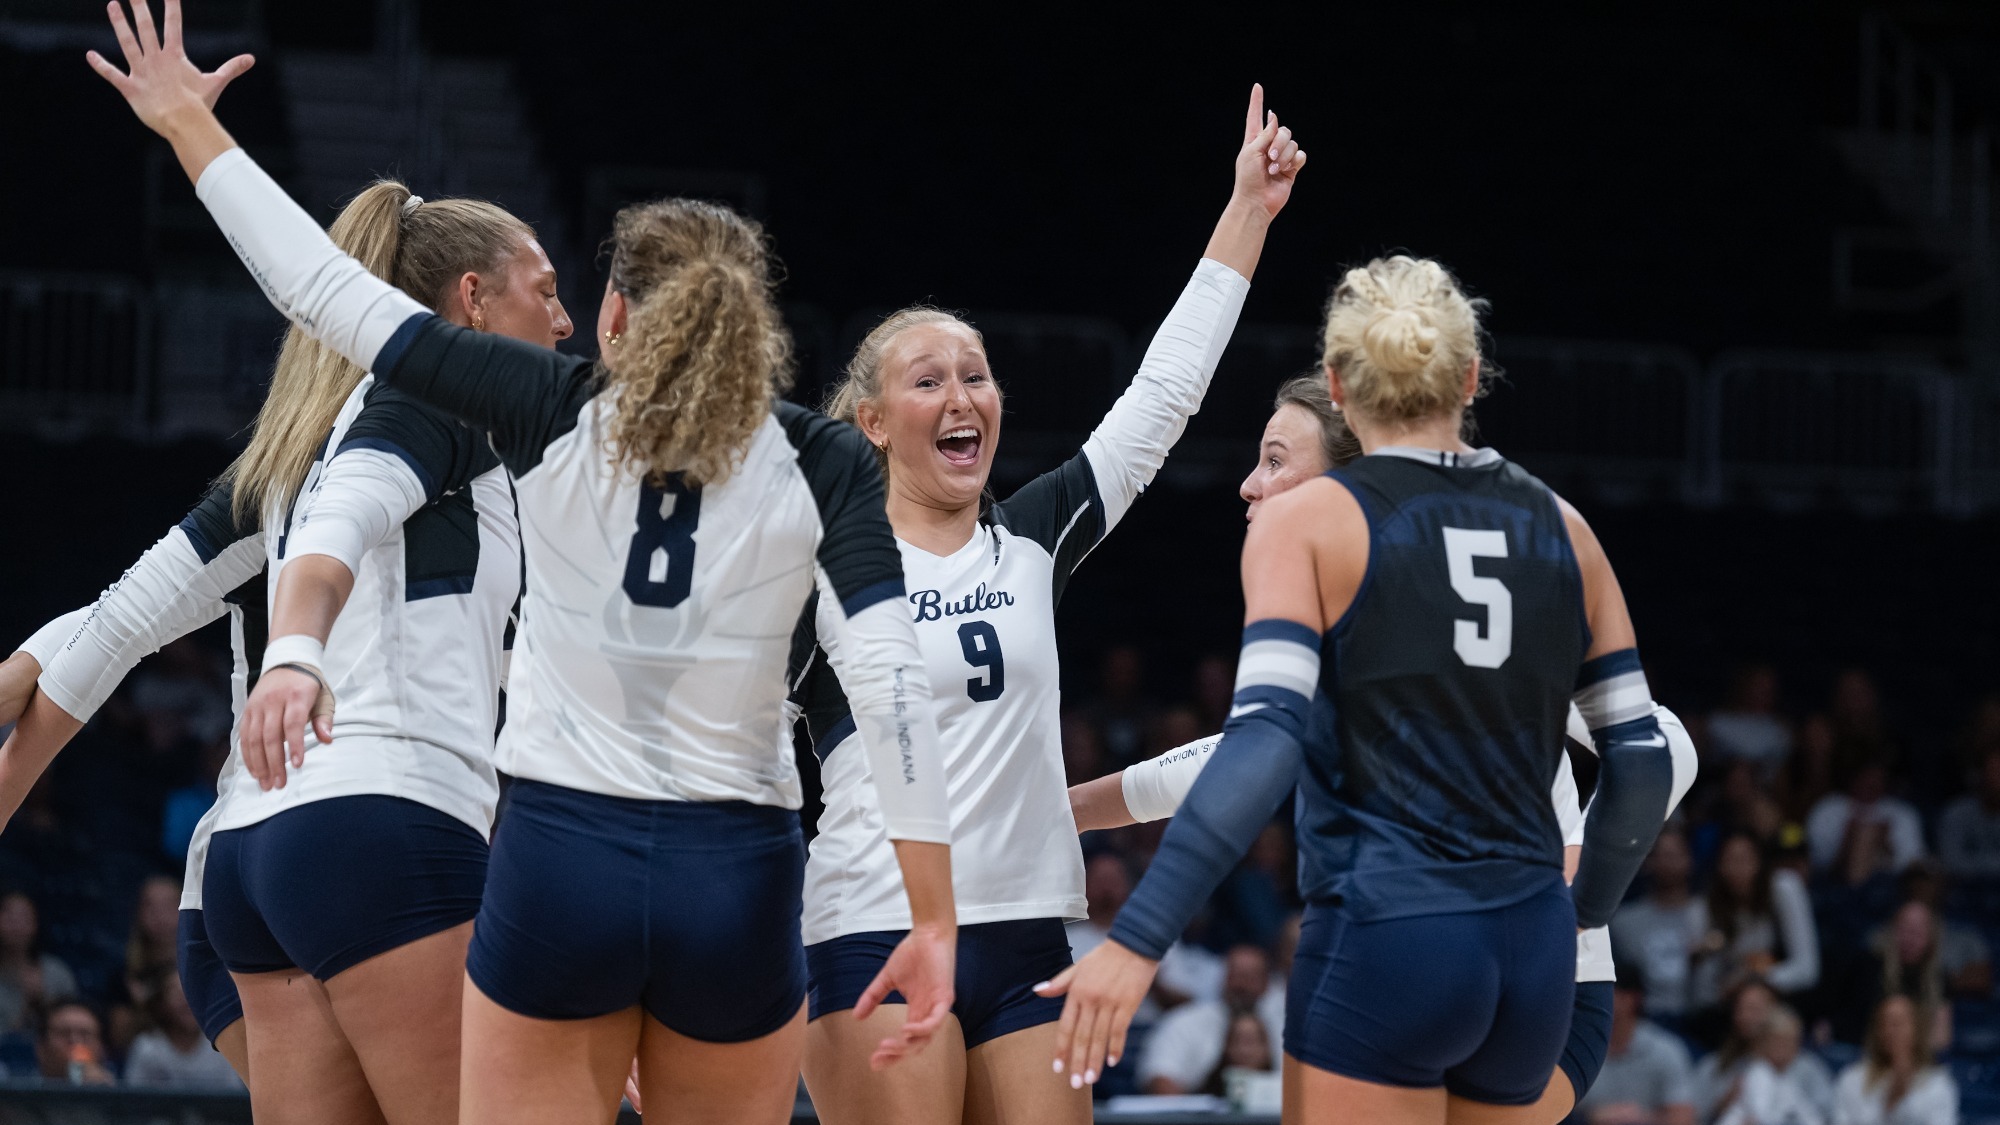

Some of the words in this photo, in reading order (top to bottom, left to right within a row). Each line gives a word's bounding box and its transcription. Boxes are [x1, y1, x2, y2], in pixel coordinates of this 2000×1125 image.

[621, 468, 703, 609] 8
[909, 582, 1015, 623] Butler
[1442, 526, 1513, 669] 5
[957, 620, 1005, 703] 9
[896, 722, 916, 786] INDIANA
[1159, 748, 1198, 767] INDIANA
